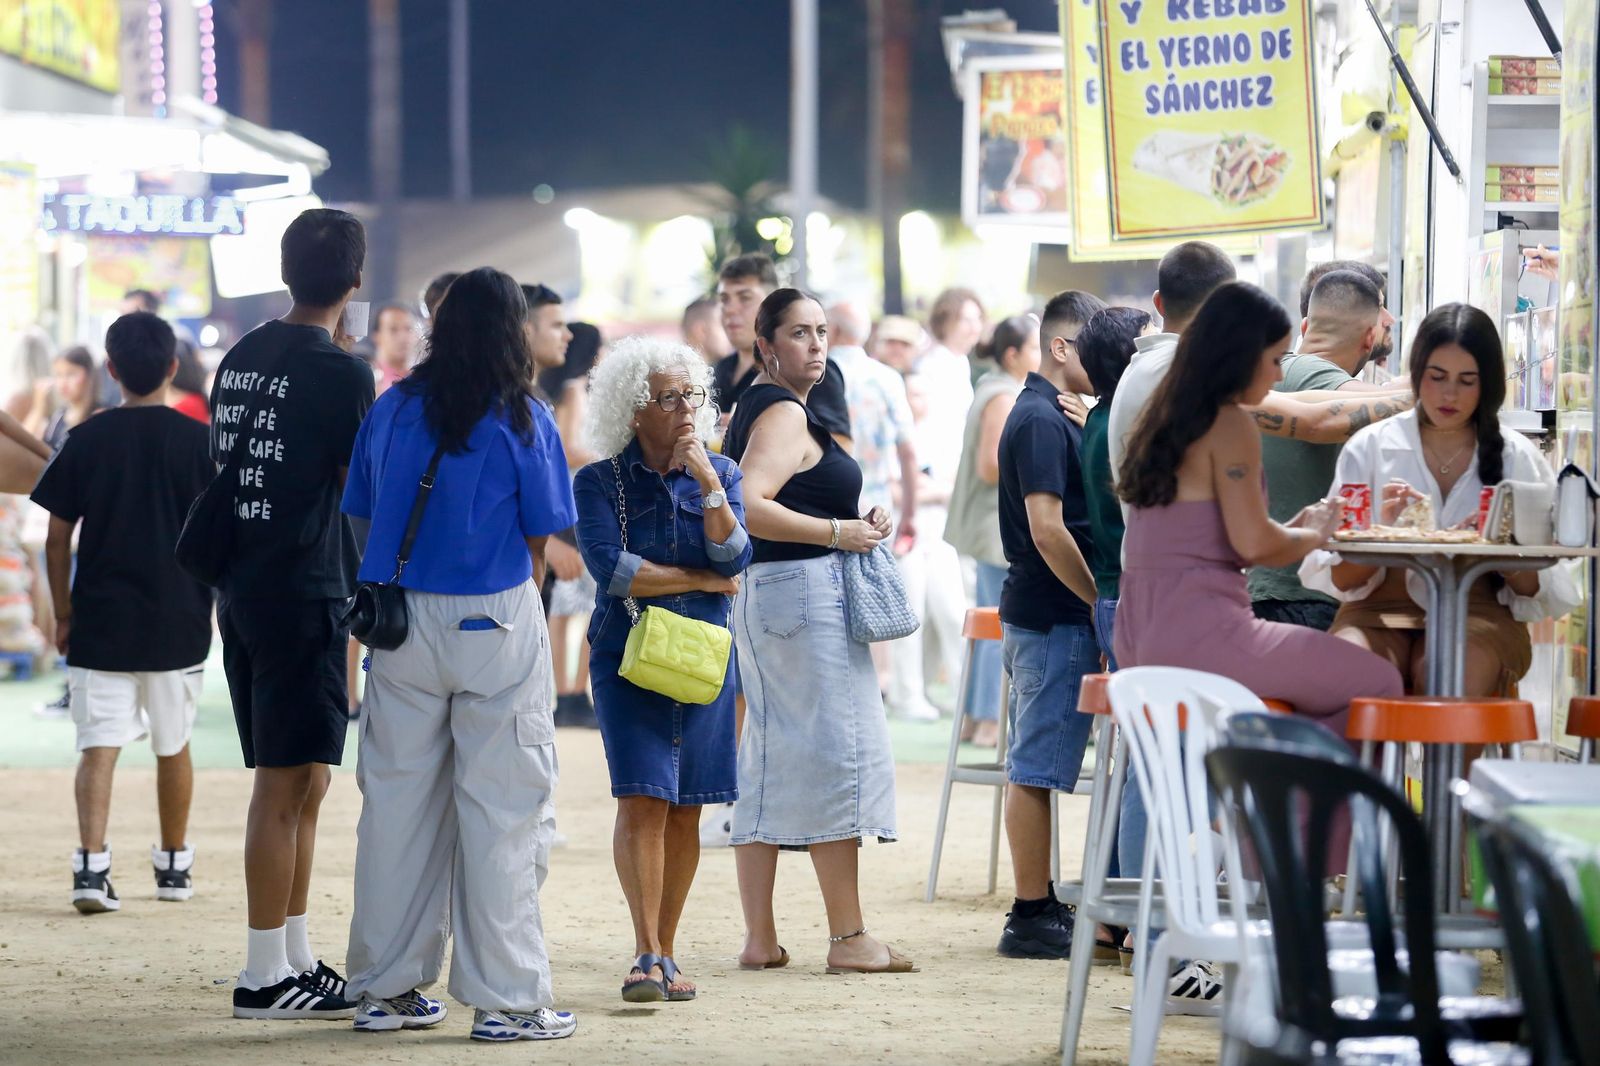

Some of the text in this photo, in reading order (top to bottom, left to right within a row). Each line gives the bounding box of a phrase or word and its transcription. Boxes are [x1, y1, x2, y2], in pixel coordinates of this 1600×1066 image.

[1120, 1, 1142, 24] Y
[1121, 28, 1292, 71] EL YERNO DE
[1145, 72, 1273, 115] SÁNCHEZ
[61, 194, 244, 234] TAQUILLA
[249, 438, 285, 462] CAFÉ
